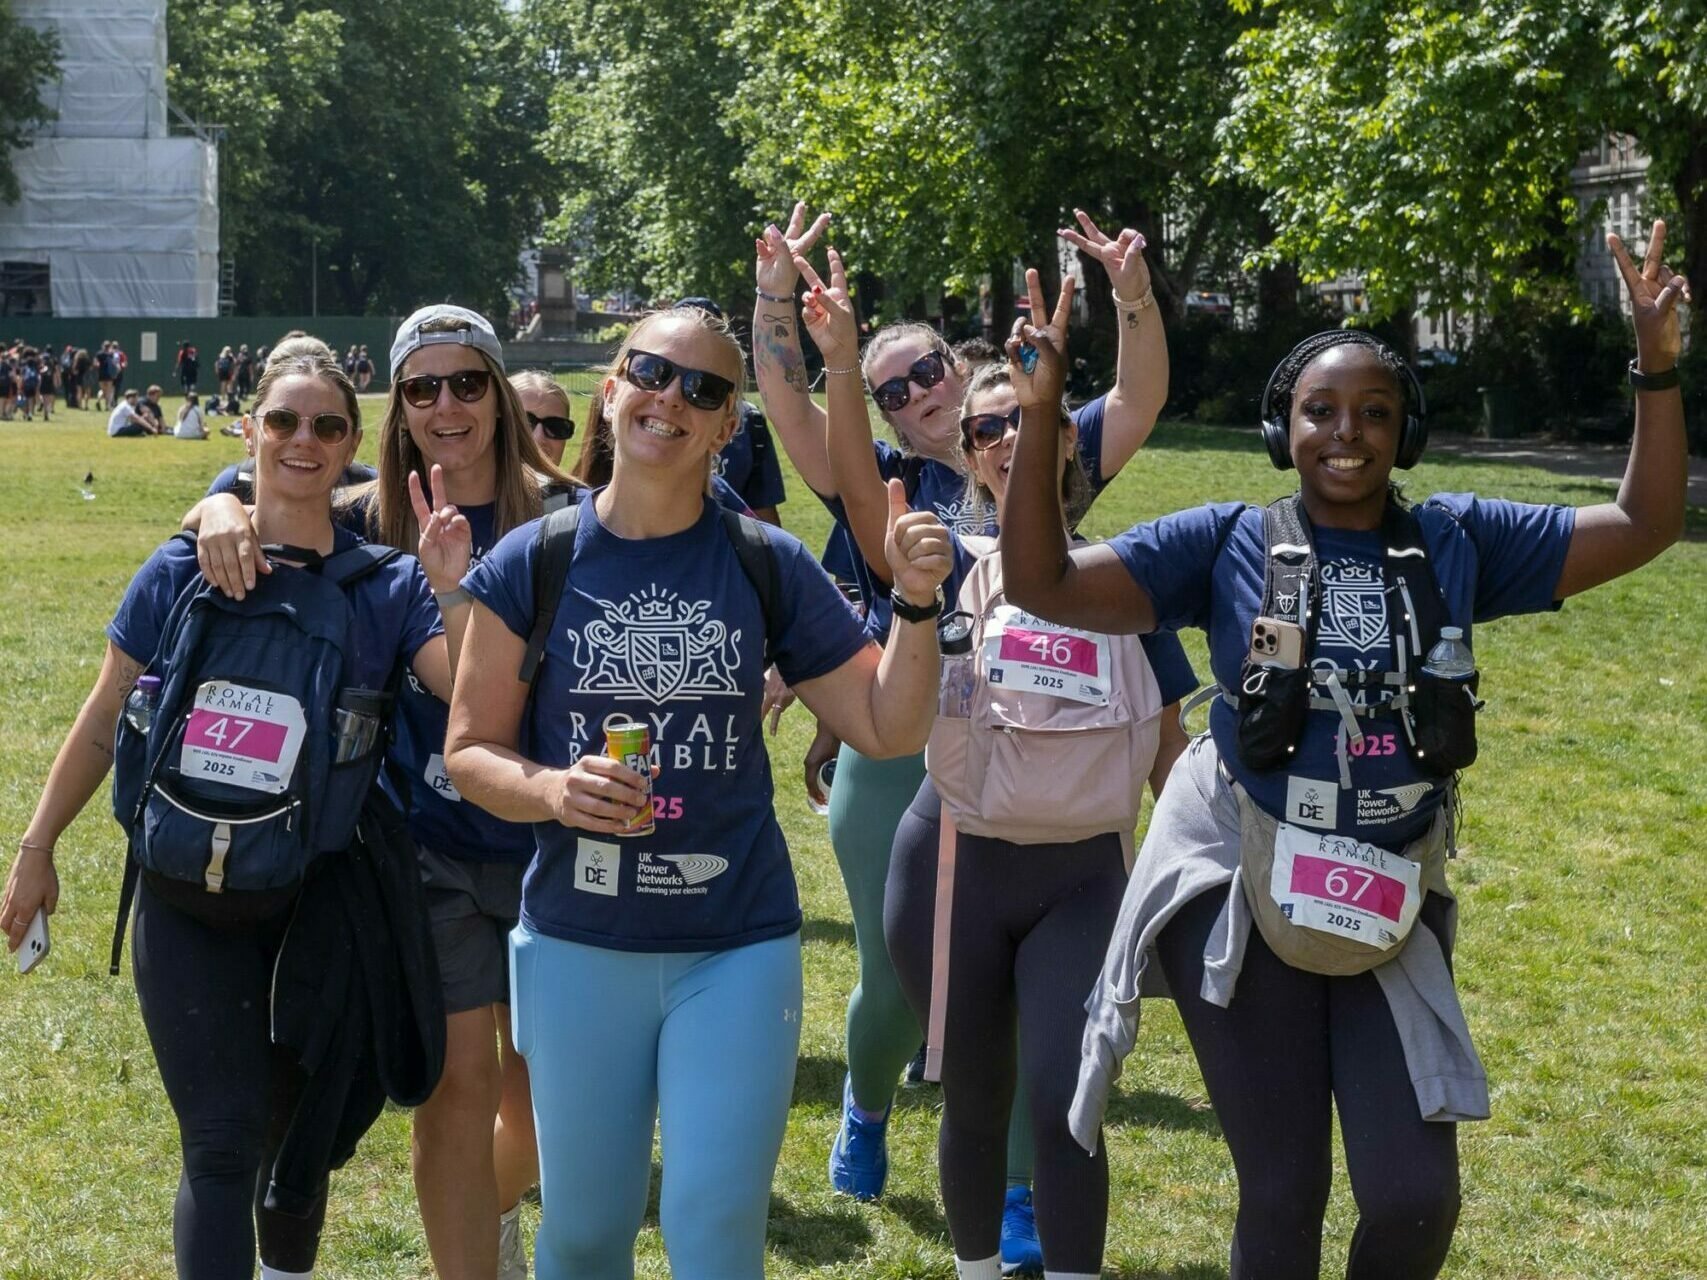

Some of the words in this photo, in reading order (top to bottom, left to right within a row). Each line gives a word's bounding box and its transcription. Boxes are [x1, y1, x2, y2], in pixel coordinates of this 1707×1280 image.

[1029, 635, 1071, 665] 46
[1033, 675, 1064, 689] 2025
[208, 685, 273, 707] ROYAL
[205, 695, 273, 715] RAMBLE
[204, 717, 254, 749] 47
[1334, 734, 1397, 757] 025
[203, 760, 235, 775] 2025
[1358, 789, 1371, 799] UK
[1357, 799, 1388, 808] Power
[1357, 805, 1400, 817] Networks
[639, 853, 652, 862] UK
[638, 863, 668, 874] Power
[637, 874, 683, 885] Networks
[1325, 867, 1375, 901] 67
[636, 886, 668, 895] Delivering
[682, 887, 708, 895] electricity
[1327, 913, 1361, 931] 2025
